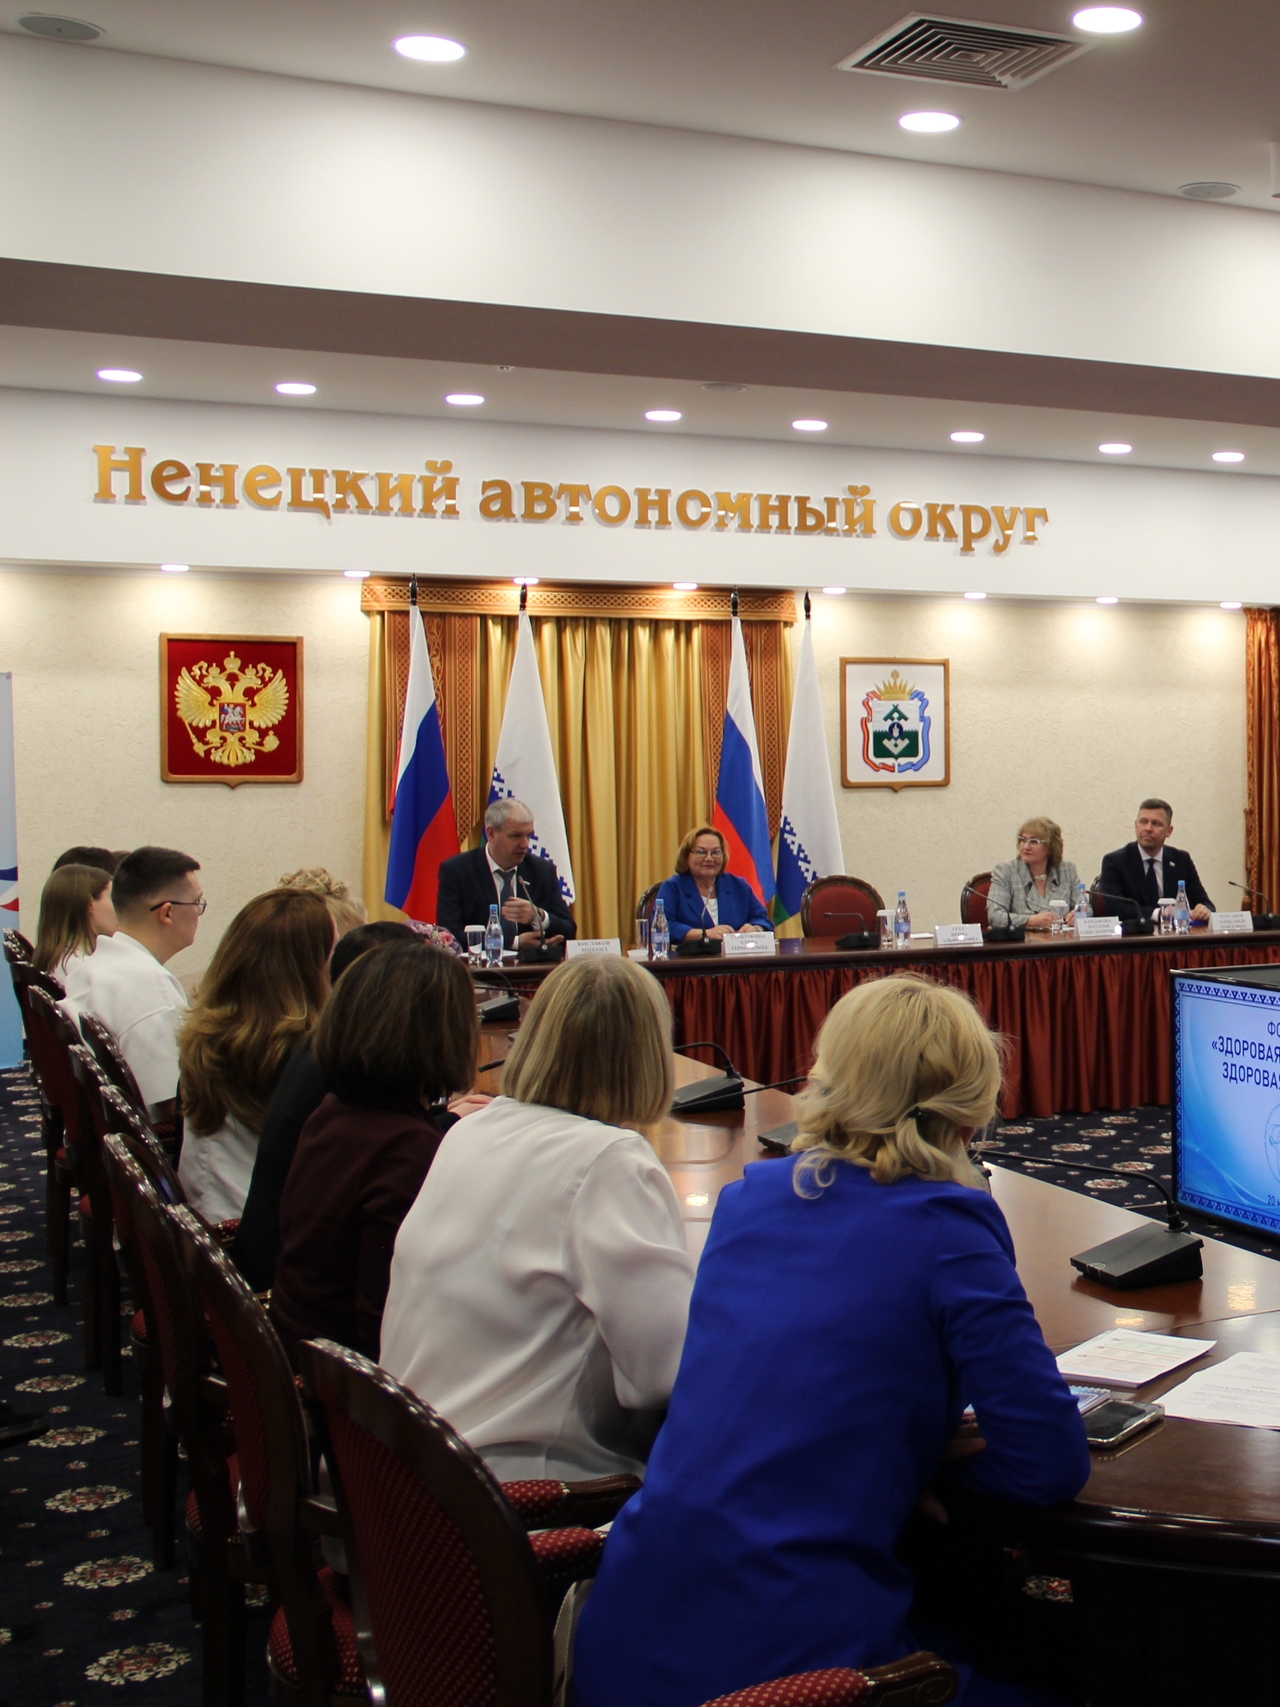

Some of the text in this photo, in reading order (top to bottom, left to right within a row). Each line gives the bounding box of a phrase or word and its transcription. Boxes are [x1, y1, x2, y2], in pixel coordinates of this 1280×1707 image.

[92, 444, 1049, 553] Ненецкий автономный округ
[1267, 1194, 1276, 1206] 20
